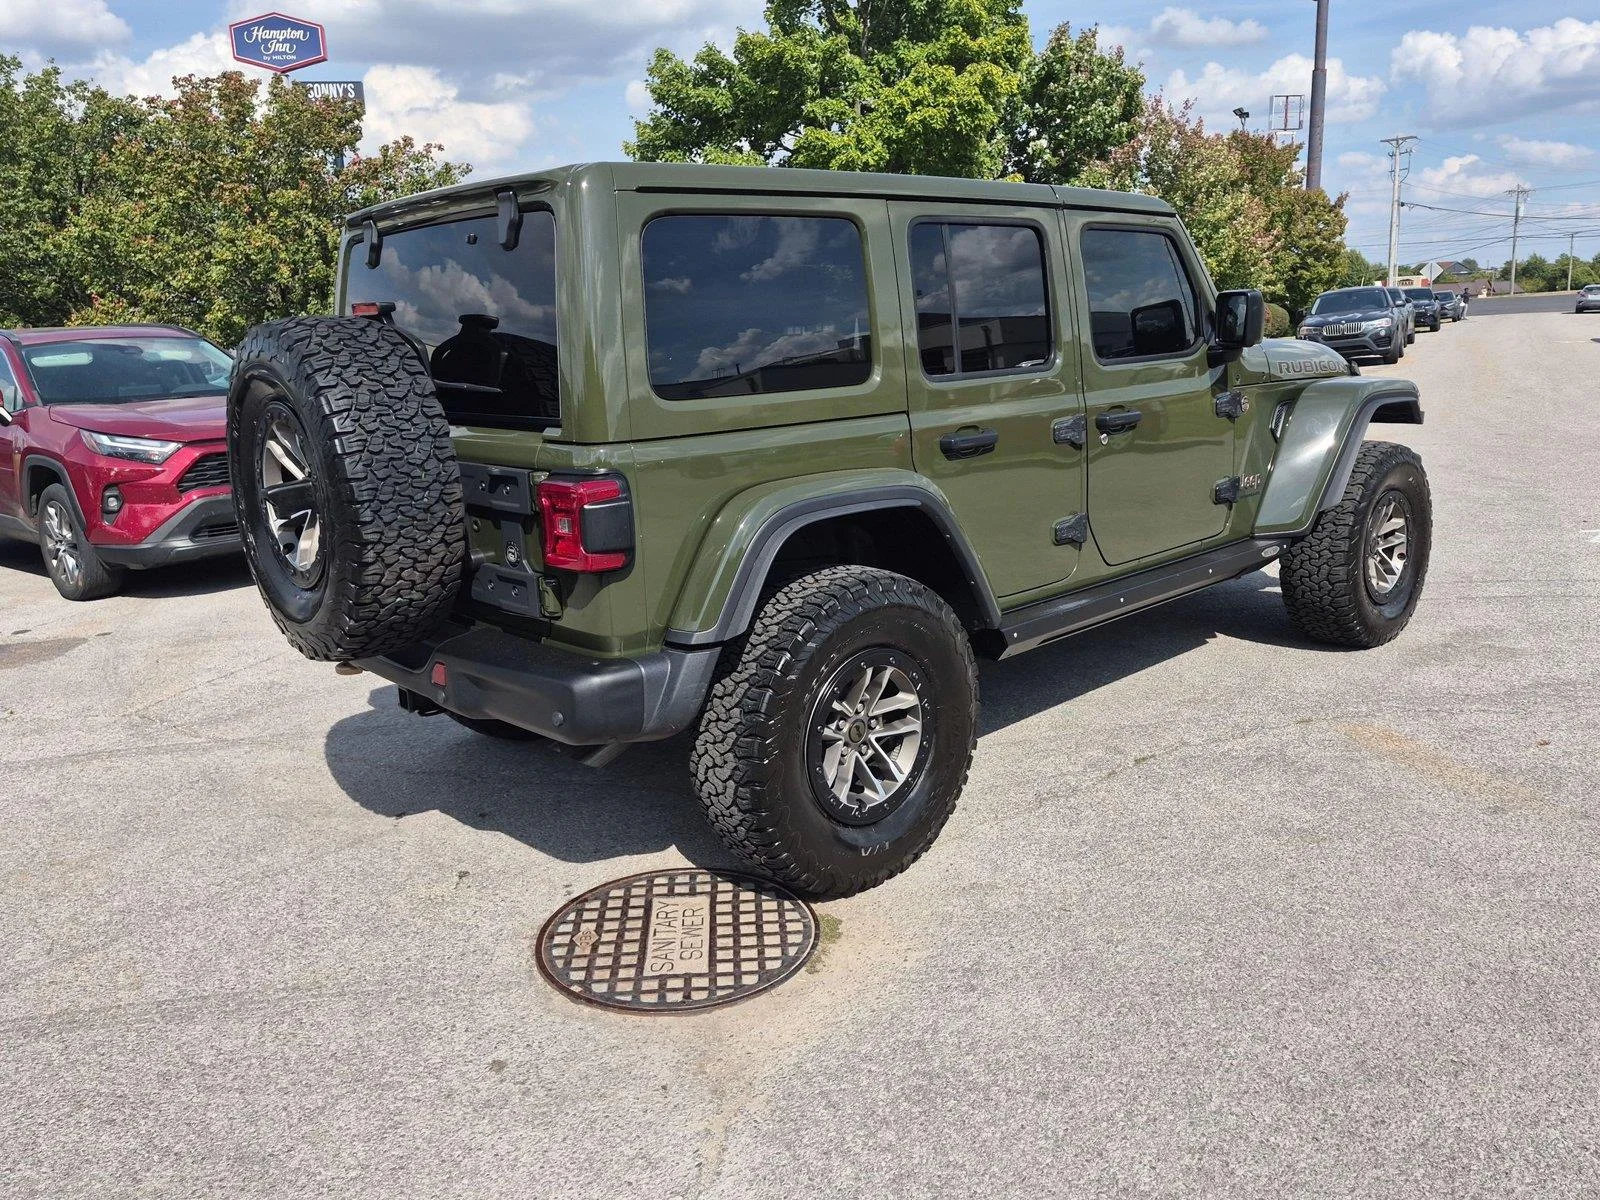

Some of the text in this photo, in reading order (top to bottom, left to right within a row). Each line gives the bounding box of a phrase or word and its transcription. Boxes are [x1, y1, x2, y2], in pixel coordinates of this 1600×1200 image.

[244, 25, 310, 43] Hampton
[261, 39, 296, 55] Inn
[1277, 360, 1348, 375] RUBICON
[650, 901, 679, 972] SANITARY
[679, 907, 704, 960] SEWER
